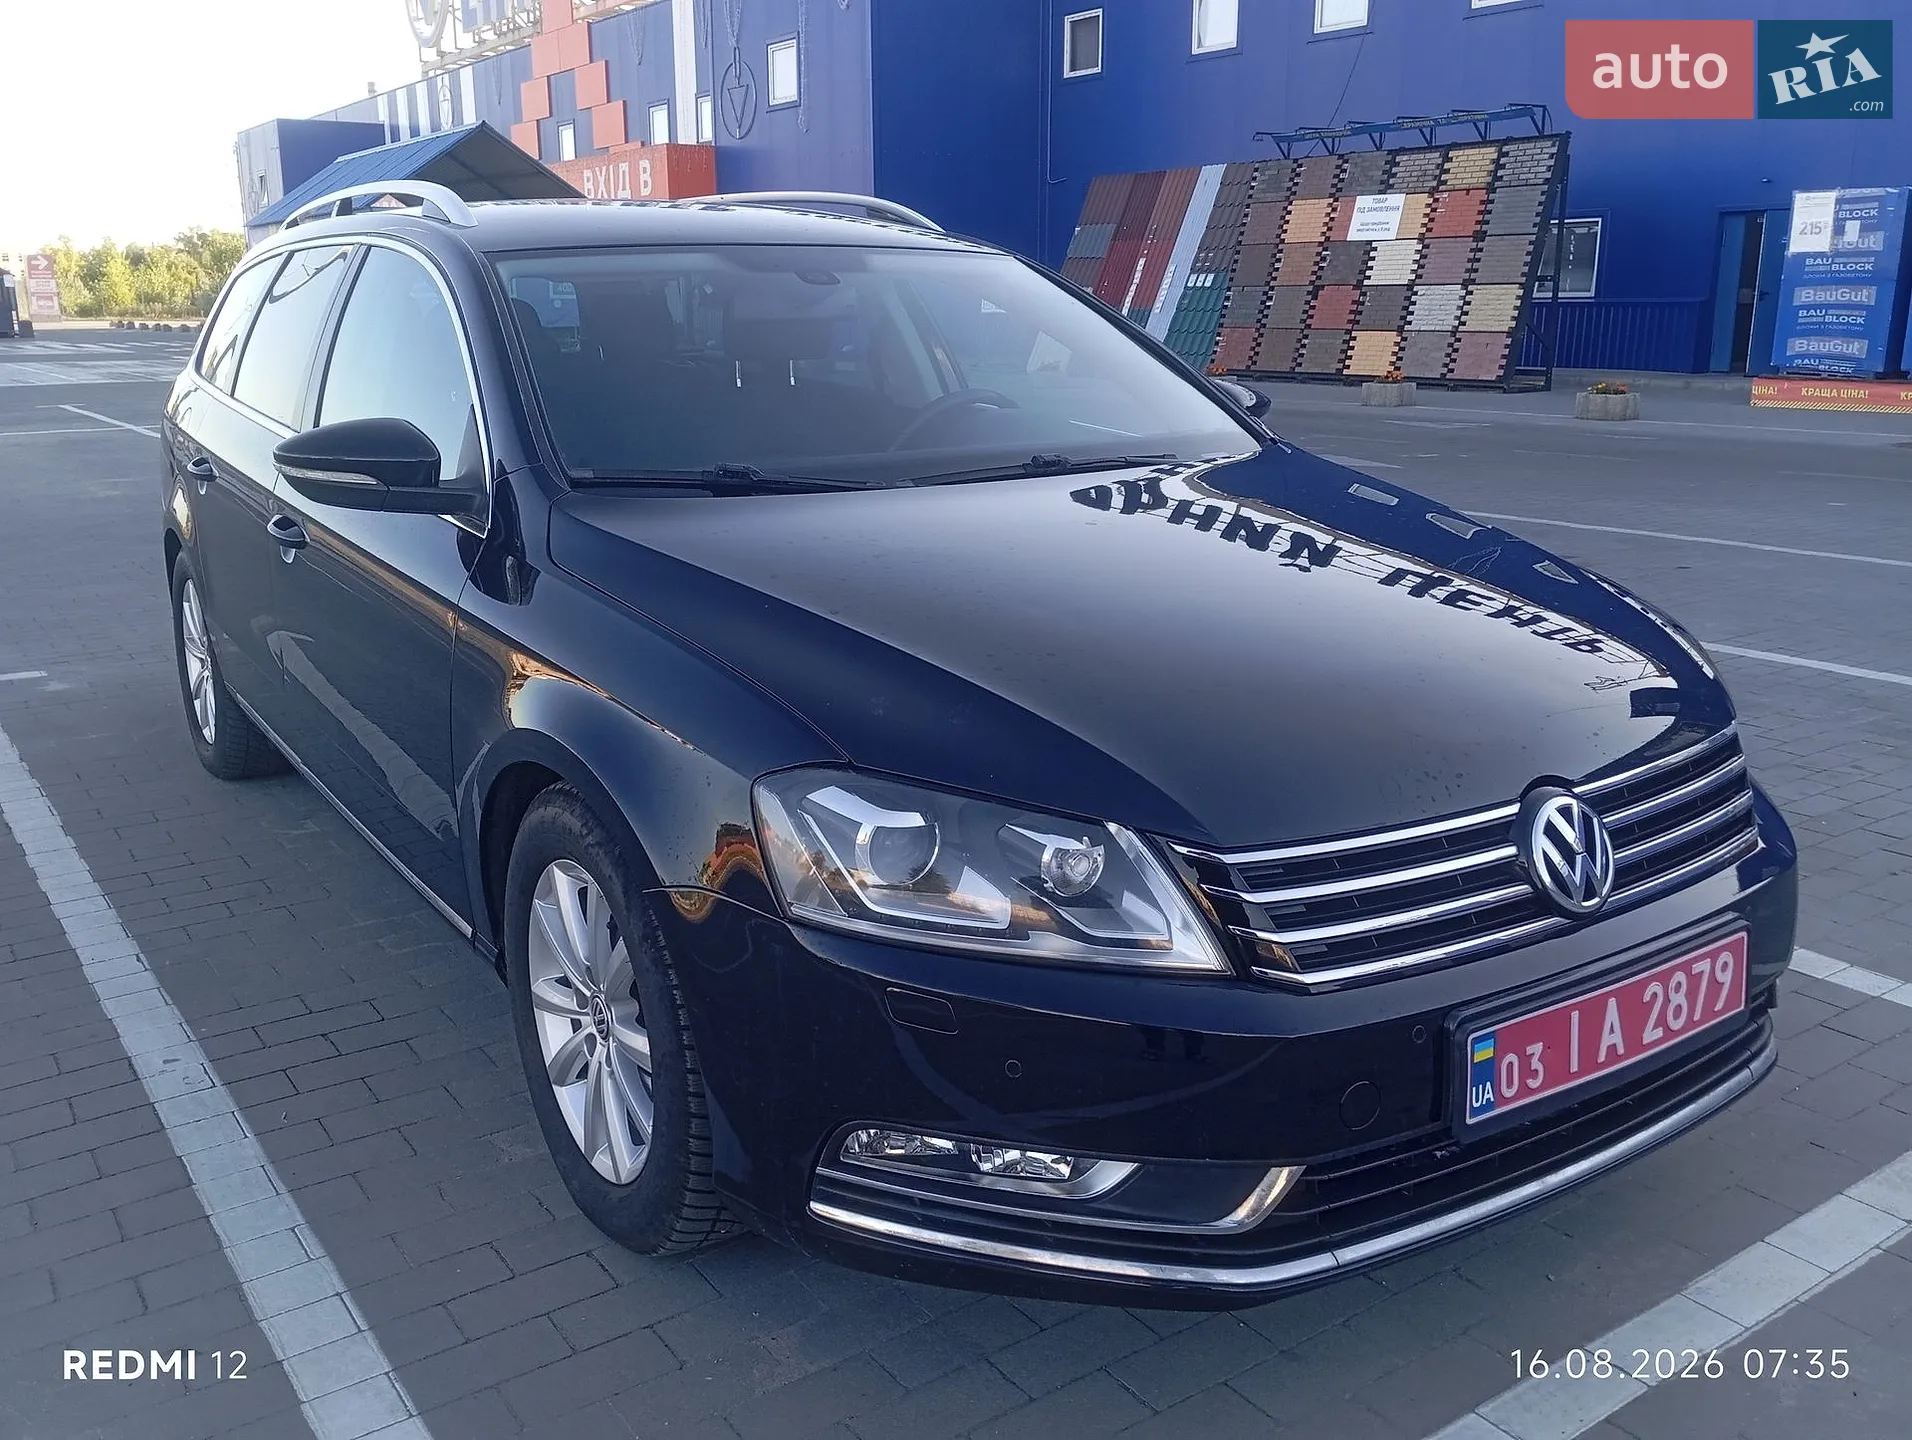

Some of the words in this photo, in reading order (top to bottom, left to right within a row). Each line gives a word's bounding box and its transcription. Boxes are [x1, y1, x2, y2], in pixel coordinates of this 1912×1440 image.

[583, 162, 632, 200] ВХІД
[640, 159, 652, 197] В
[1838, 209, 1879, 218] BLOCK
[1799, 221, 1823, 236] 215
[1805, 257, 1832, 265] BAU
[1831, 263, 1874, 271] BLOCK
[1800, 288, 1869, 302] BauGut
[1798, 309, 1826, 317] BAU
[1825, 315, 1865, 324] BLOCK
[1794, 340, 1860, 355] BauGut
[1752, 385, 1778, 395] ЦІНА!
[1801, 387, 1839, 398] КРАЩА
[1841, 390, 1869, 399] ЦІНА!
[1500, 1041, 1545, 1098] 03
[1642, 951, 1735, 1047] 2879
[1471, 1081, 1494, 1108] UA
